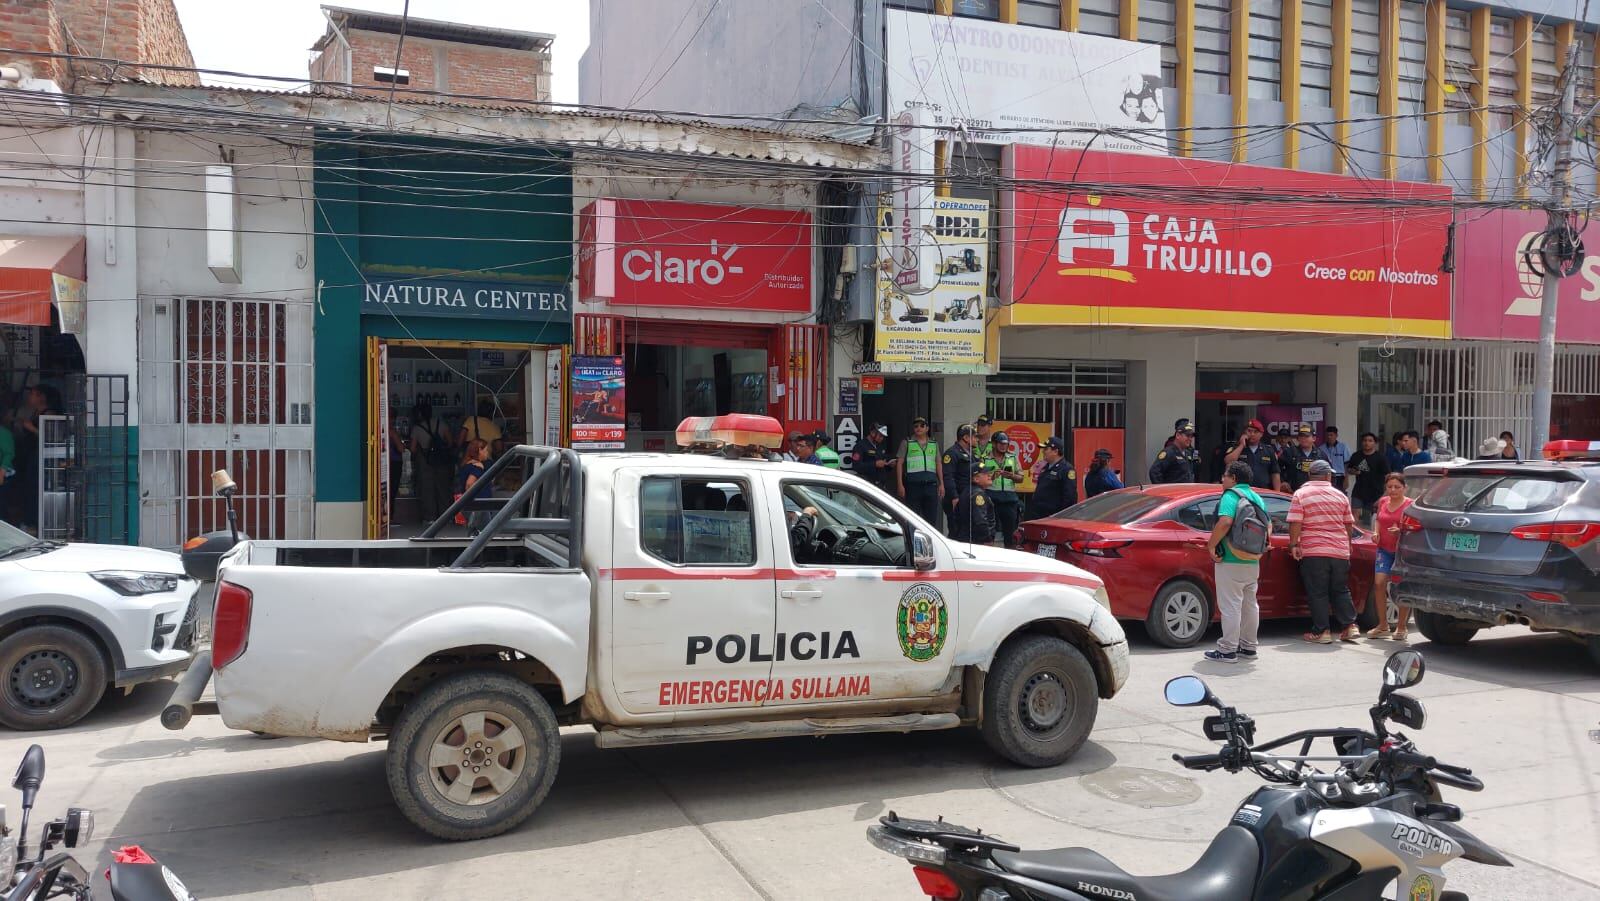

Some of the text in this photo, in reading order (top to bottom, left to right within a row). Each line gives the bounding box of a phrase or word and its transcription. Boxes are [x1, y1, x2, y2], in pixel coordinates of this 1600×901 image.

[932, 22, 1003, 50] CENTRO
[1141, 213, 1219, 245] CAJA
[622, 249, 725, 286] Claro
[1142, 243, 1273, 279] TRUJILLO
[1304, 262, 1439, 287] Crece con Nosotros
[763, 273, 805, 283] Distribuidor
[768, 281, 805, 290] Autorizado
[364, 283, 568, 312] NATURA CENTER
[686, 630, 861, 665] POLICIA
[659, 675, 871, 706] EMERGENCIA SULLANA
[1391, 823, 1453, 855] POLICIA
[1076, 880, 1136, 900] HONDA
